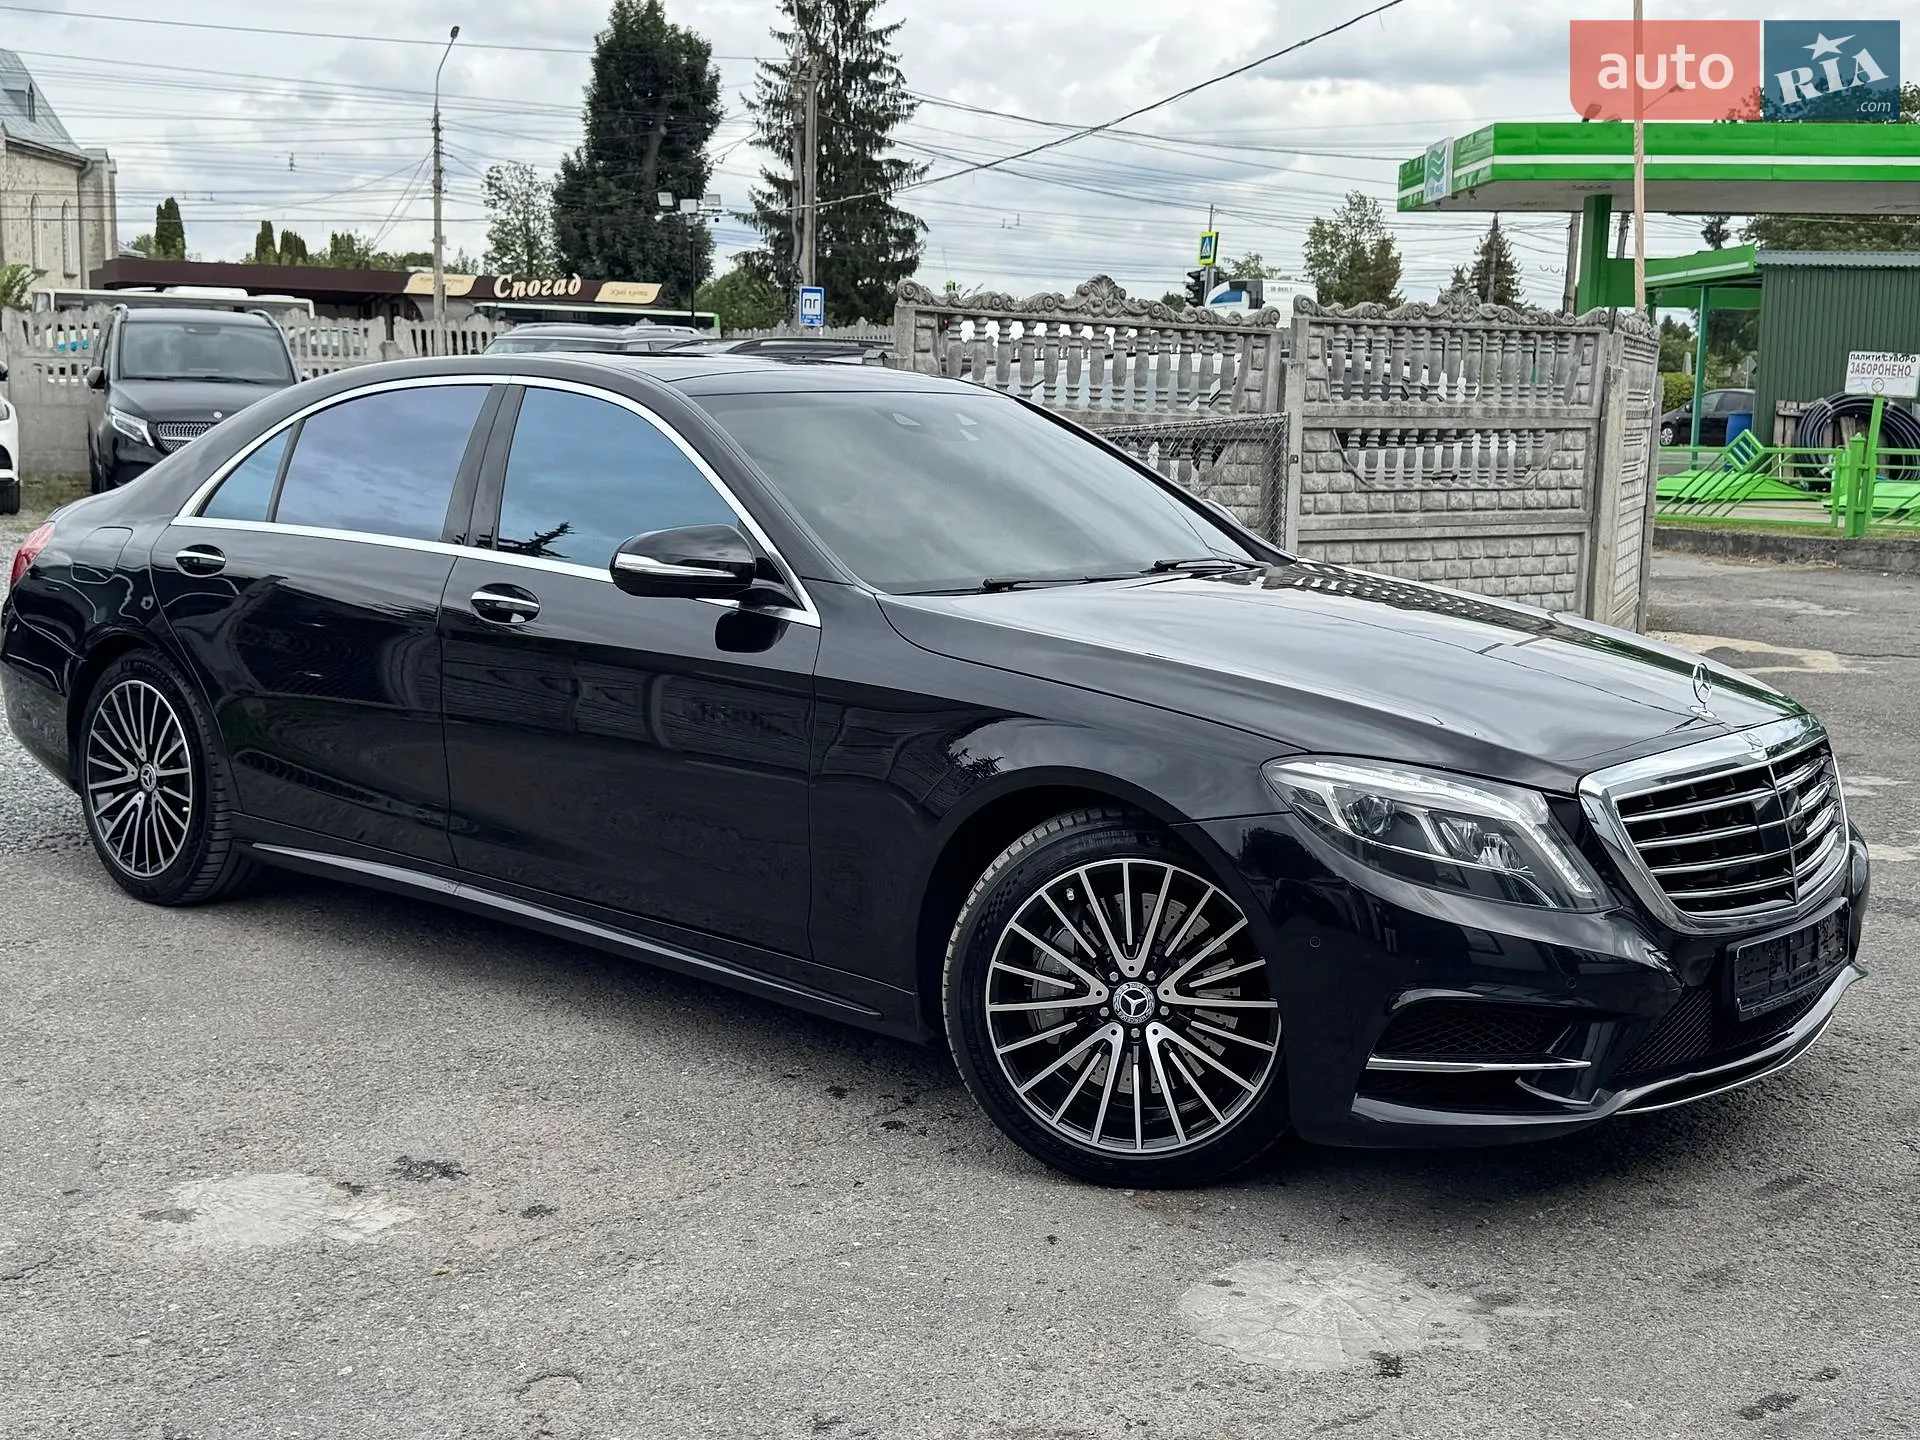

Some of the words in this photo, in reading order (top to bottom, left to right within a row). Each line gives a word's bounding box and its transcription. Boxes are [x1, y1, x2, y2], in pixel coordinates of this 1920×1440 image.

[493, 272, 582, 299] Спогад
[1850, 353, 1881, 361] ПАЛИТИ
[1850, 363, 1911, 376] ЗАБОРОНЕНО
